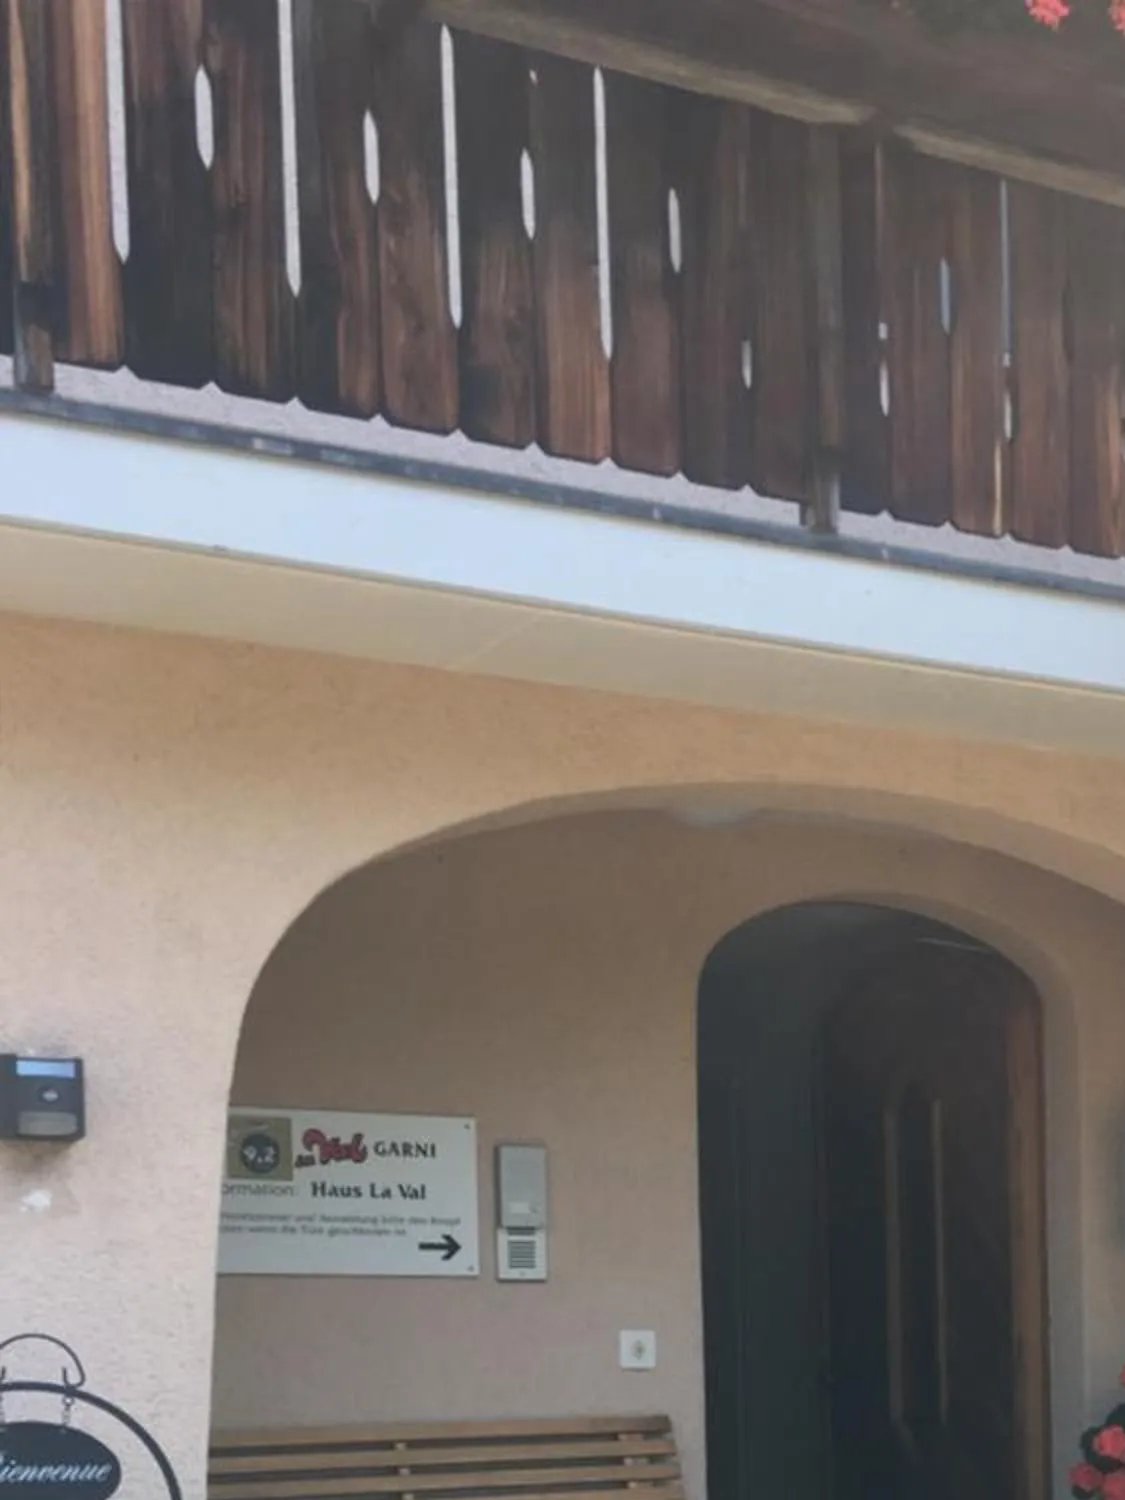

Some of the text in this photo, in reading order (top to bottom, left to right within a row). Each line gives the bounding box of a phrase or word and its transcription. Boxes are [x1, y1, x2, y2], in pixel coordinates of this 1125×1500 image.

[373, 1140, 436, 1158] GARNI
[310, 1181, 426, 1200] Haus La Val
